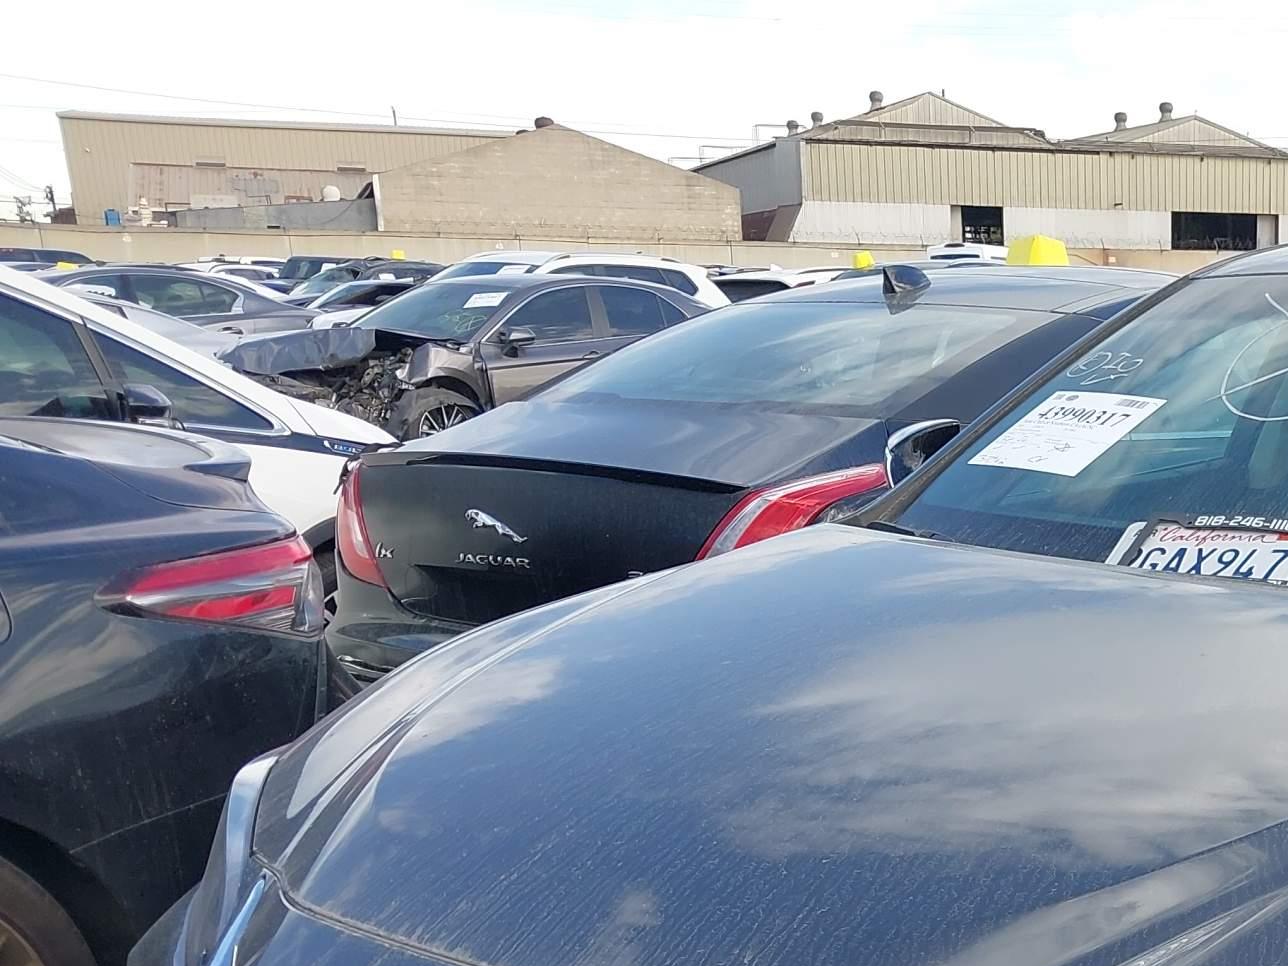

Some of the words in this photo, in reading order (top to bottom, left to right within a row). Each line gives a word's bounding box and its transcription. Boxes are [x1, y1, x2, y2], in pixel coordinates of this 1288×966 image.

[1037, 404, 1133, 428] 43990317
[1159, 526, 1277, 547] California
[454, 552, 531, 569] JAGUAR
